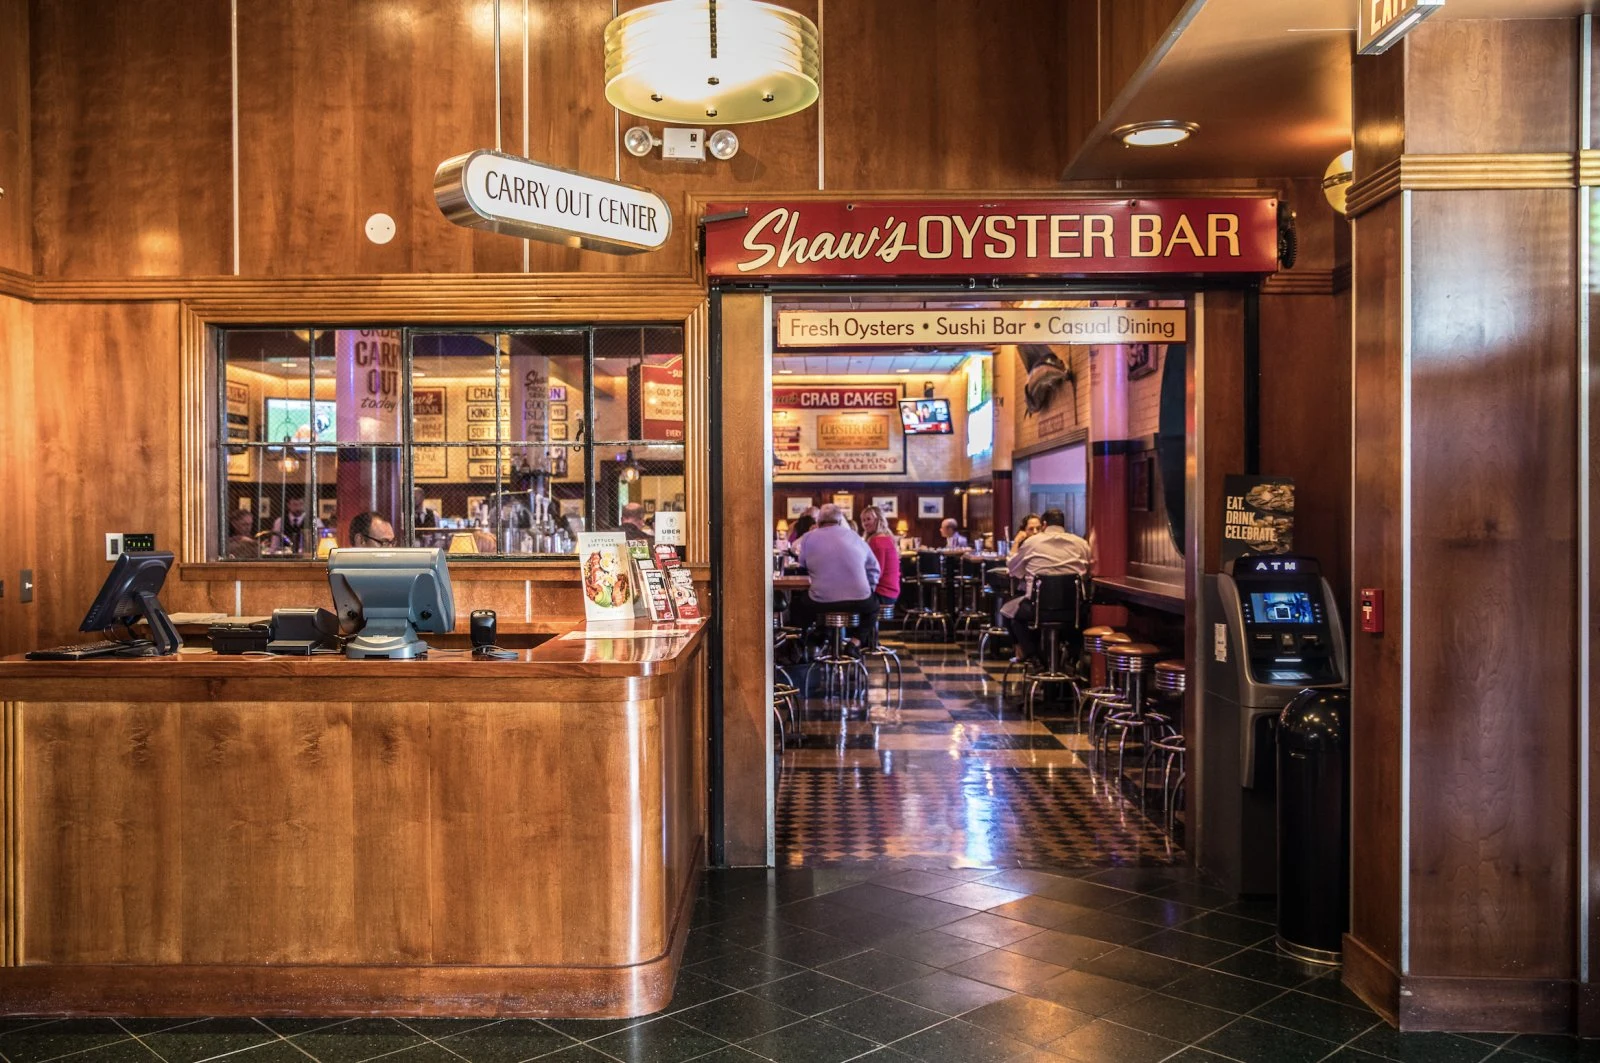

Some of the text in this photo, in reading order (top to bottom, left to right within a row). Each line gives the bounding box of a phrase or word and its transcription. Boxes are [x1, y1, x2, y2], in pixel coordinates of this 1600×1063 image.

[485, 170, 658, 233] CARRY OUT CENTER
[737, 207, 1241, 272] Shaw's OYSTER BAR
[791, 316, 1175, 340] Fresh Oysters Sushi Bar Casual Dining
[355, 341, 401, 369] CARR
[368, 368, 399, 396] OUT
[474, 387, 497, 399] CRA
[800, 392, 839, 406] CRAB
[844, 392, 893, 406] CAKES
[361, 396, 397, 413] today
[471, 408, 490, 418] KING
[867, 456, 898, 464] KING
[1227, 496, 1245, 510] EAT.
[1226, 510, 1258, 525] DRINK.
[1225, 525, 1278, 542] CELEBRATE.
[1256, 562, 1296, 570] ATM
